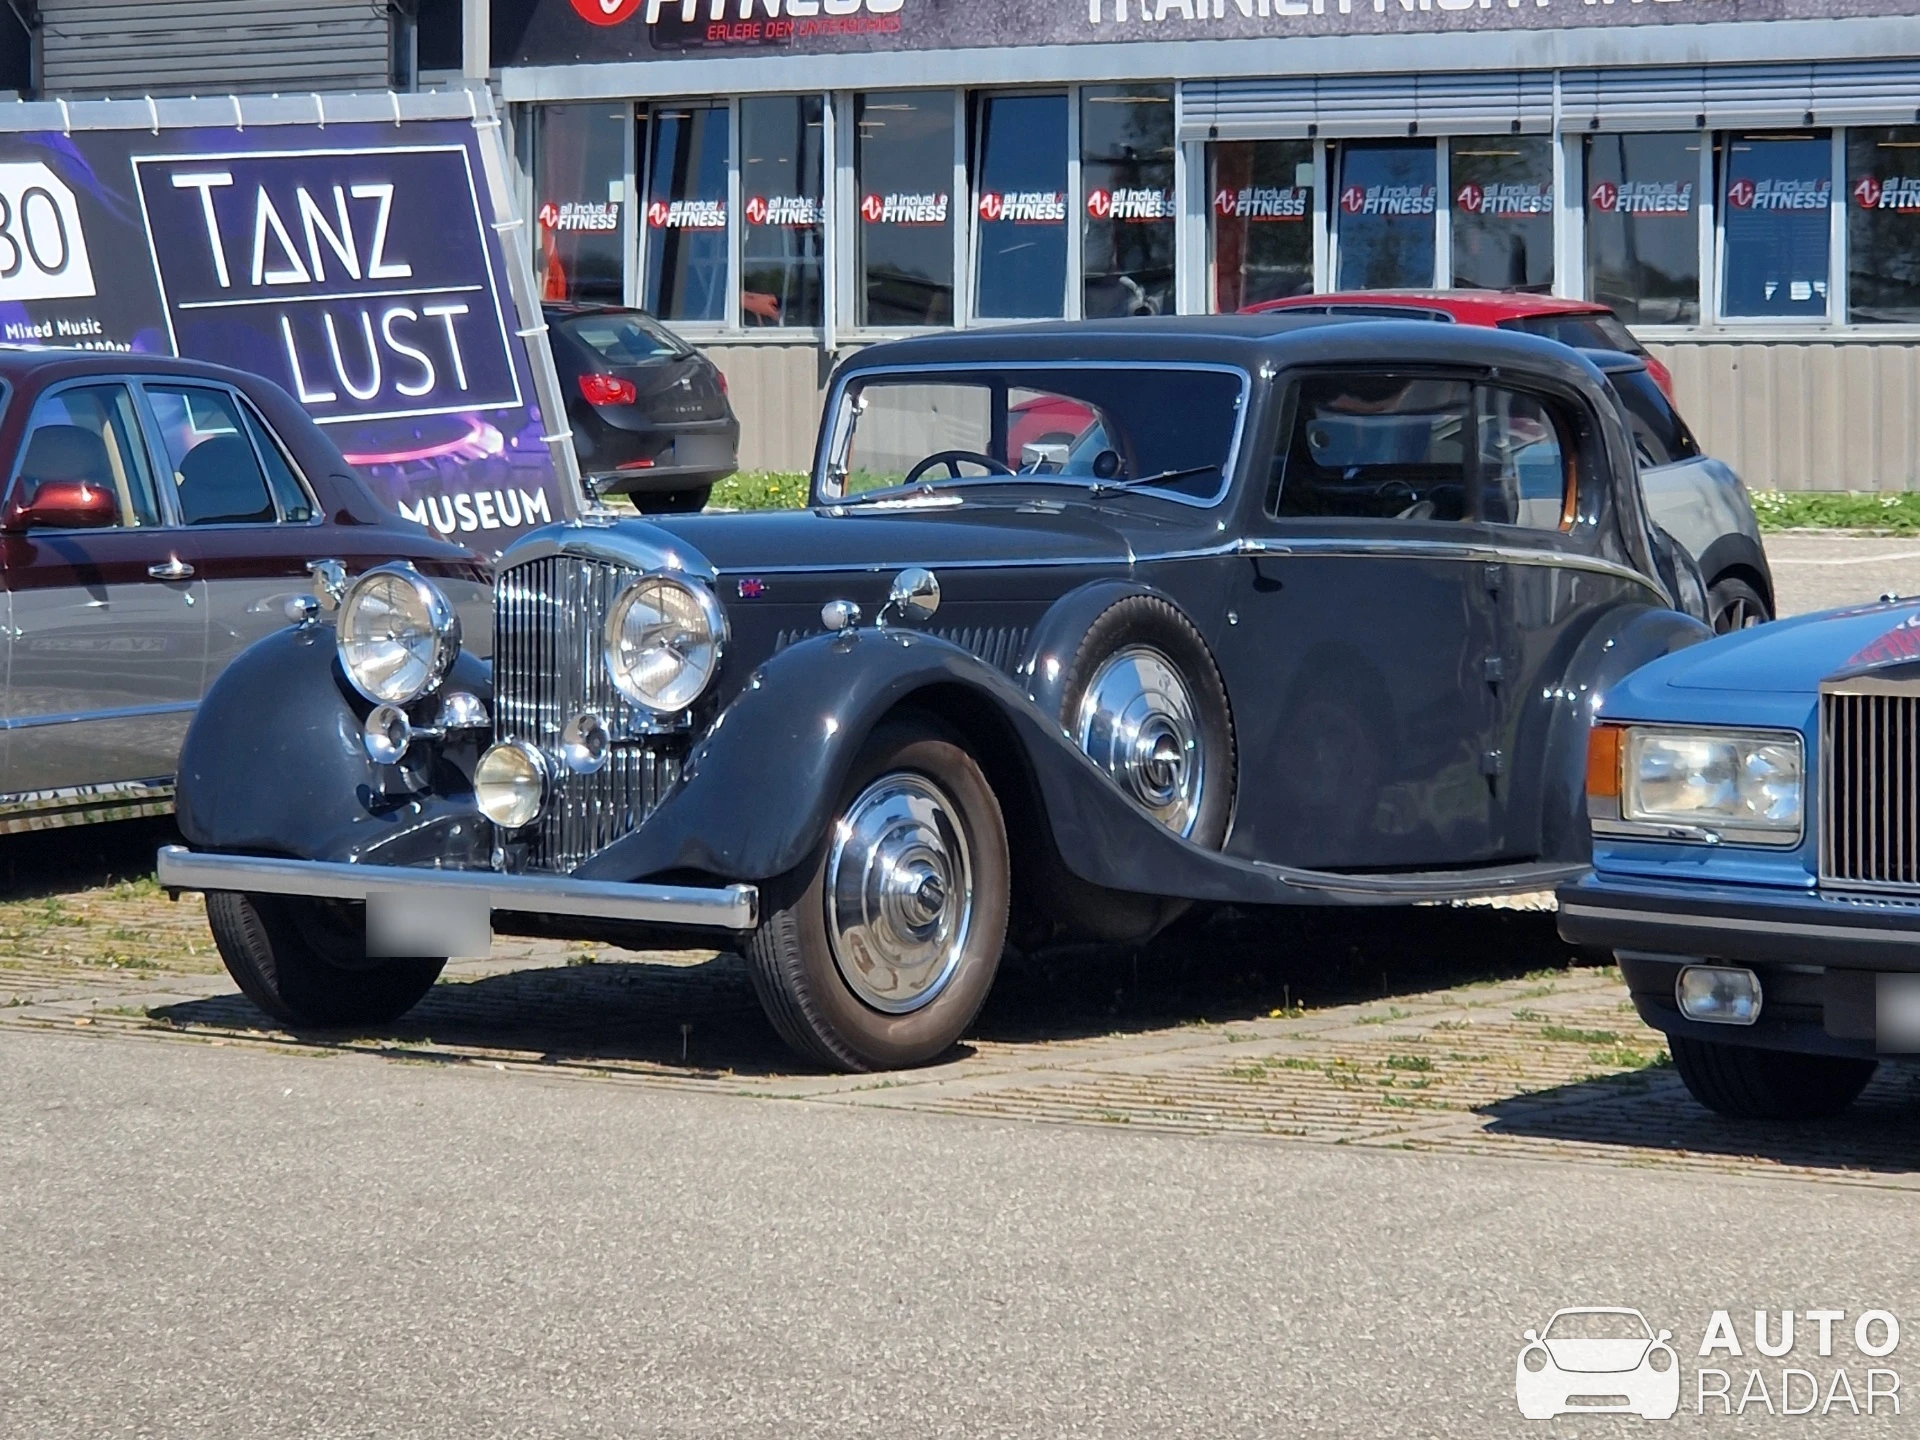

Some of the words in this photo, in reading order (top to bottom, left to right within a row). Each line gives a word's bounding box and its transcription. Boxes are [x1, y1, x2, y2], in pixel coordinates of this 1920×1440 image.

[707, 23, 761, 41] ERLEBE
[765, 20, 795, 39] DEN
[1366, 185, 1380, 198] all
[1483, 183, 1498, 196] all
[1618, 182, 1633, 195] all
[1755, 179, 1771, 192] all
[1882, 177, 1898, 191] all
[884, 193, 897, 205] all
[1003, 192, 1016, 204] all
[1111, 188, 1124, 201] all
[1238, 187, 1252, 200] all
[1752, 191, 1830, 209] FITNESS
[560, 202, 572, 214] all
[670, 201, 683, 213] all
[768, 196, 781, 209] all
[1109, 200, 1176, 218] FITNESS
[1235, 199, 1305, 217] FITNESS
[1362, 197, 1435, 214] FITNESS
[1481, 195, 1553, 213] FITNESS
[1615, 194, 1691, 212] FITNESS
[667, 211, 726, 227] FITNESS
[766, 208, 825, 224] FITNESS
[881, 205, 946, 222] FITNESS
[1000, 203, 1066, 220] FITNESS
[172, 172, 413, 287] TANZ
[558, 214, 617, 230] FITNESS
[5, 320, 53, 340] Mixed
[57, 317, 103, 336] Music
[281, 305, 469, 404] LUST
[398, 487, 552, 534] MUSEUM
